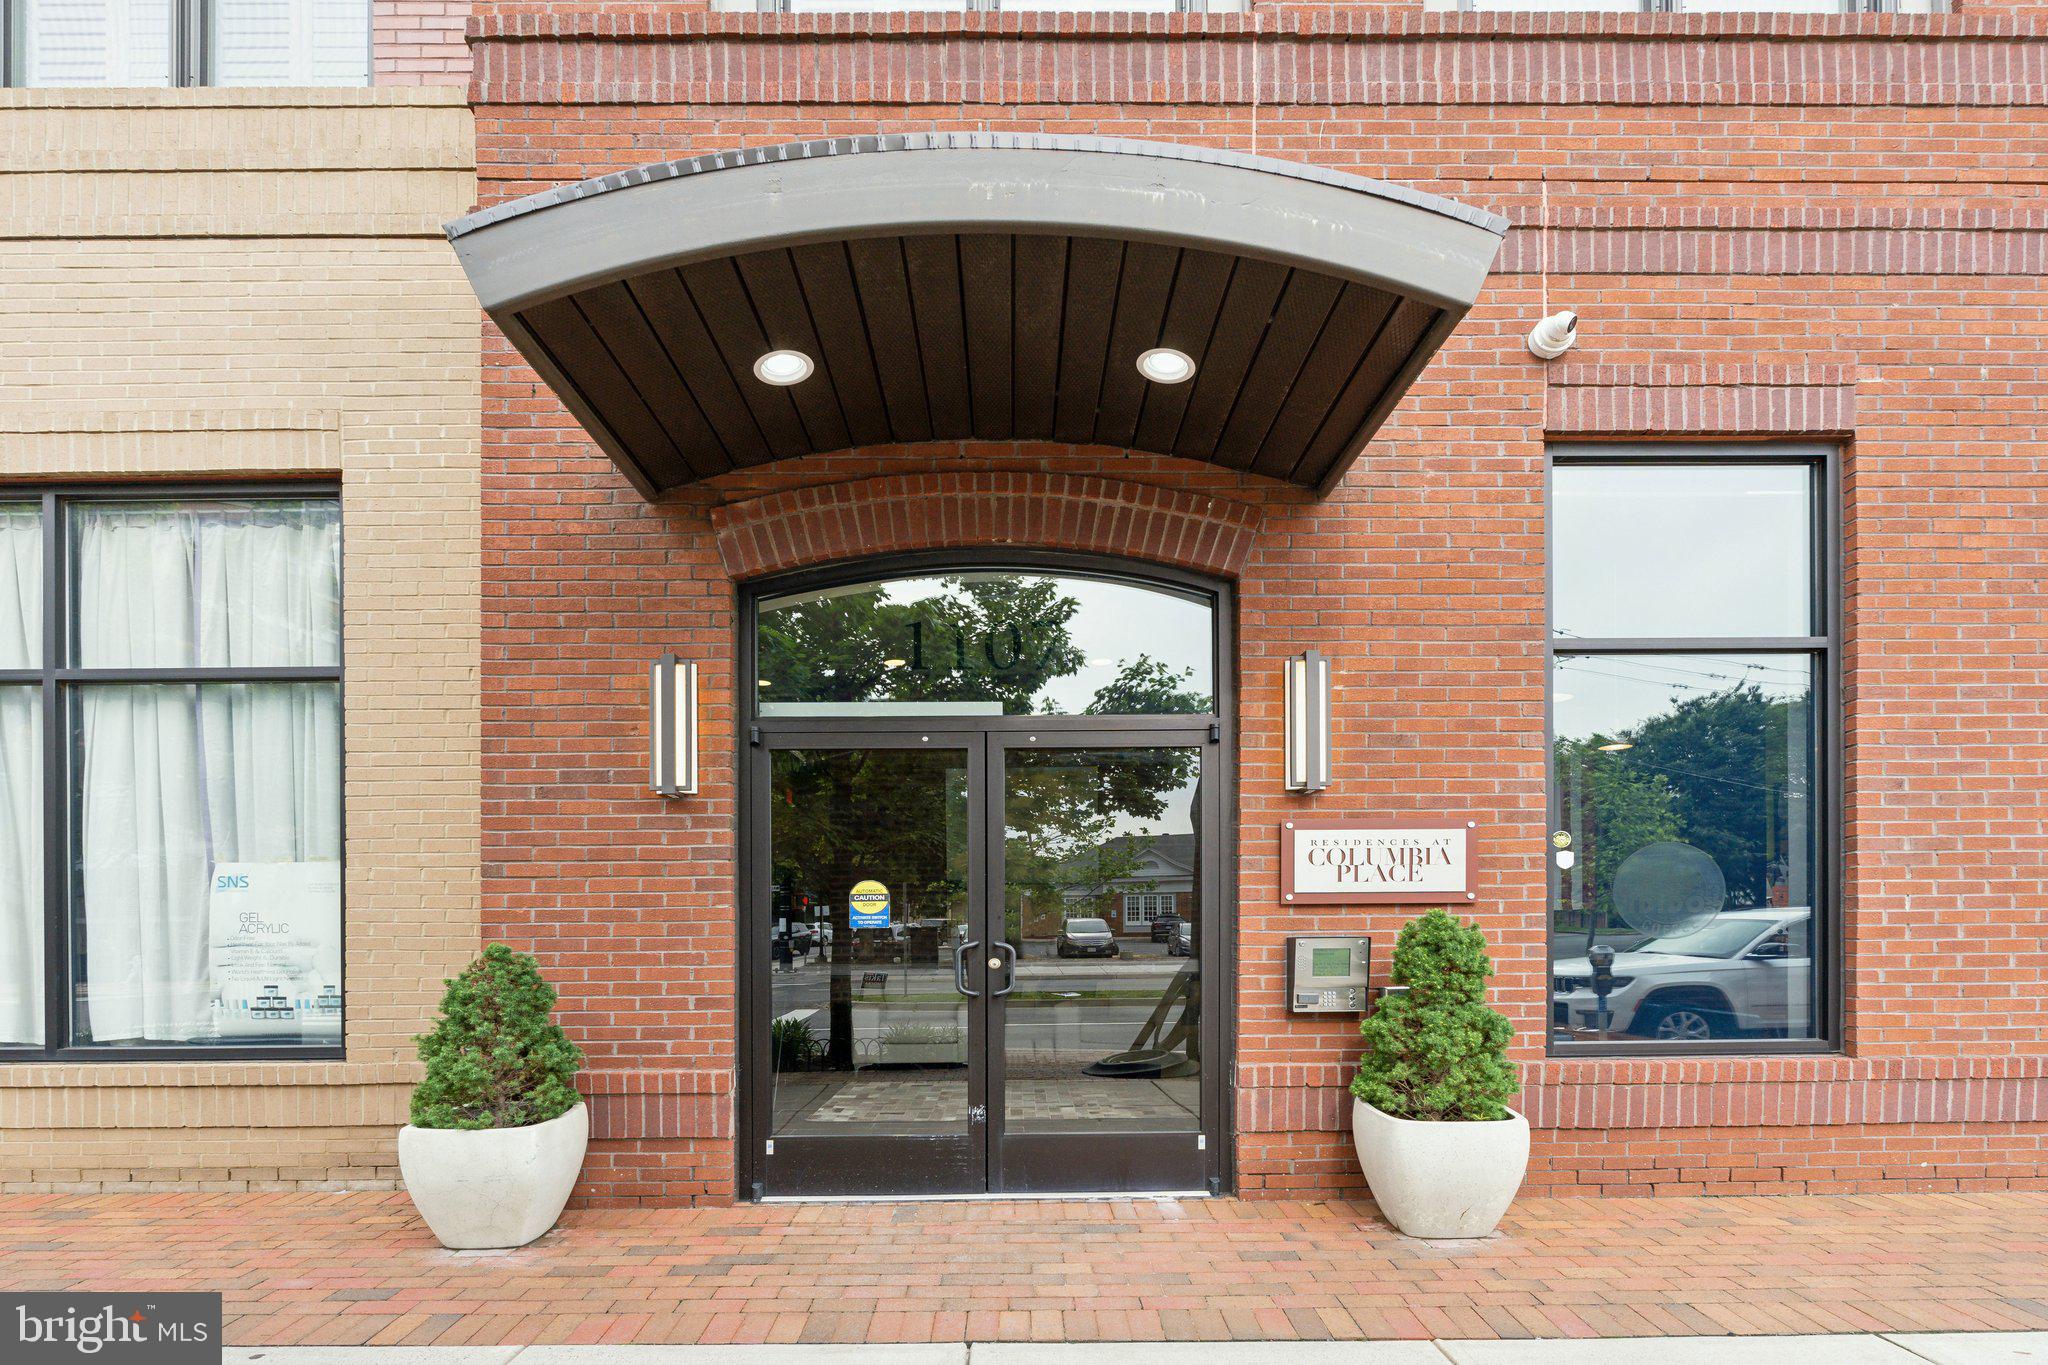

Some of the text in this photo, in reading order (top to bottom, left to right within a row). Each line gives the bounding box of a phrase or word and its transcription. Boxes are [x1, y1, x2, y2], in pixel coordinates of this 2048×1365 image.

[1310, 838, 1451, 847] RESIDENCES AT
[1307, 847, 1452, 866] COLUMBIA
[1337, 864, 1424, 883] PLACE
[218, 876, 249, 888] SNS
[240, 912, 264, 922] GEL
[239, 922, 290, 934] ACRYLIC
